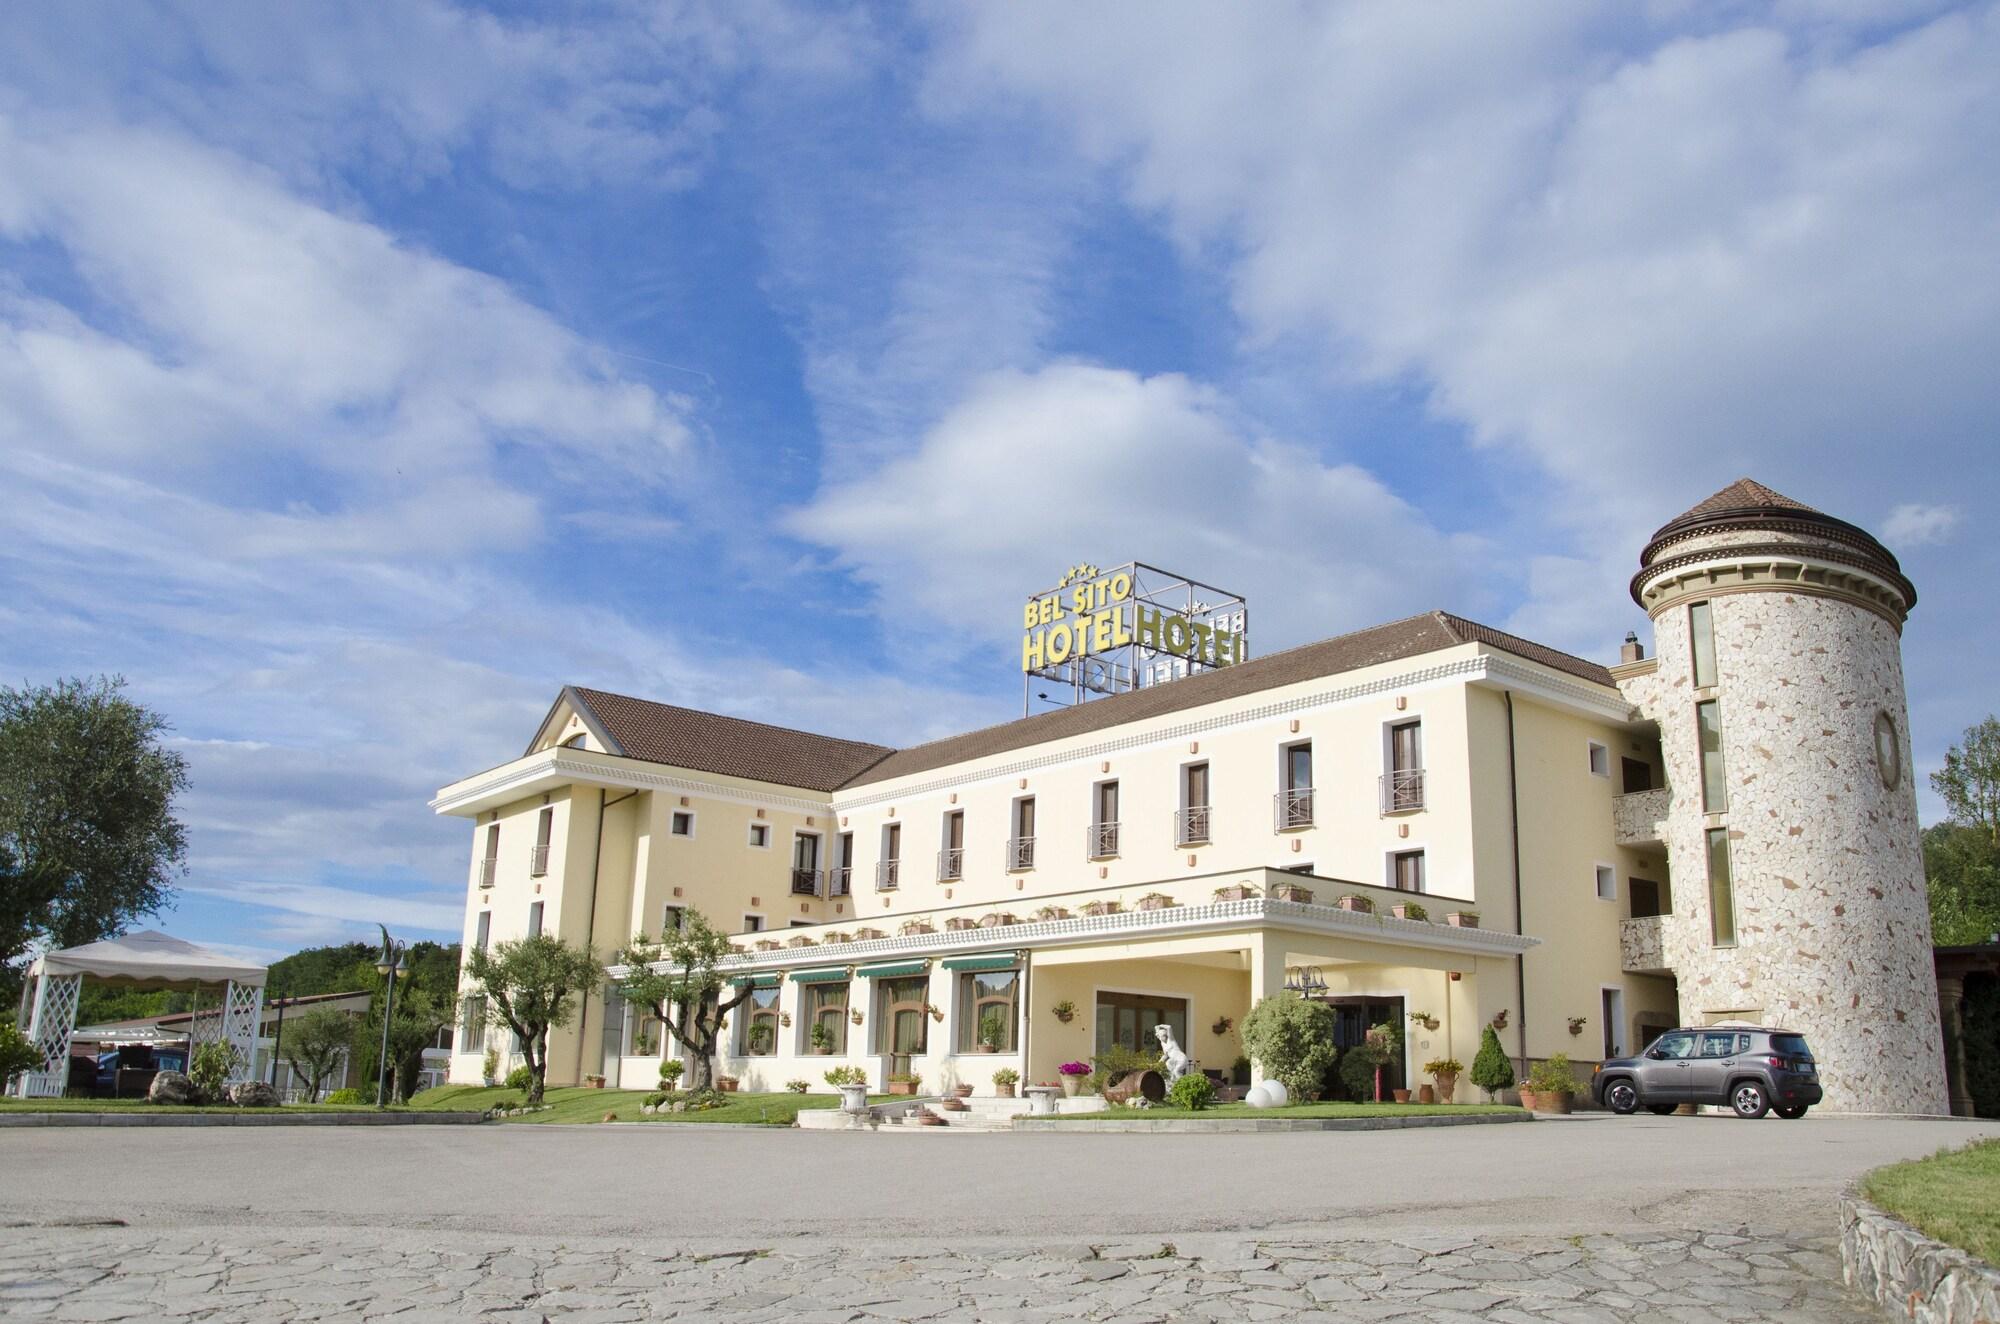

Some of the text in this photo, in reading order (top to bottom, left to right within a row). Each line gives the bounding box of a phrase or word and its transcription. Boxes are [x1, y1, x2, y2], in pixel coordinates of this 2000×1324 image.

[1024, 572, 1132, 629] BEL SITO
[1022, 606, 1130, 672] HOTEL
